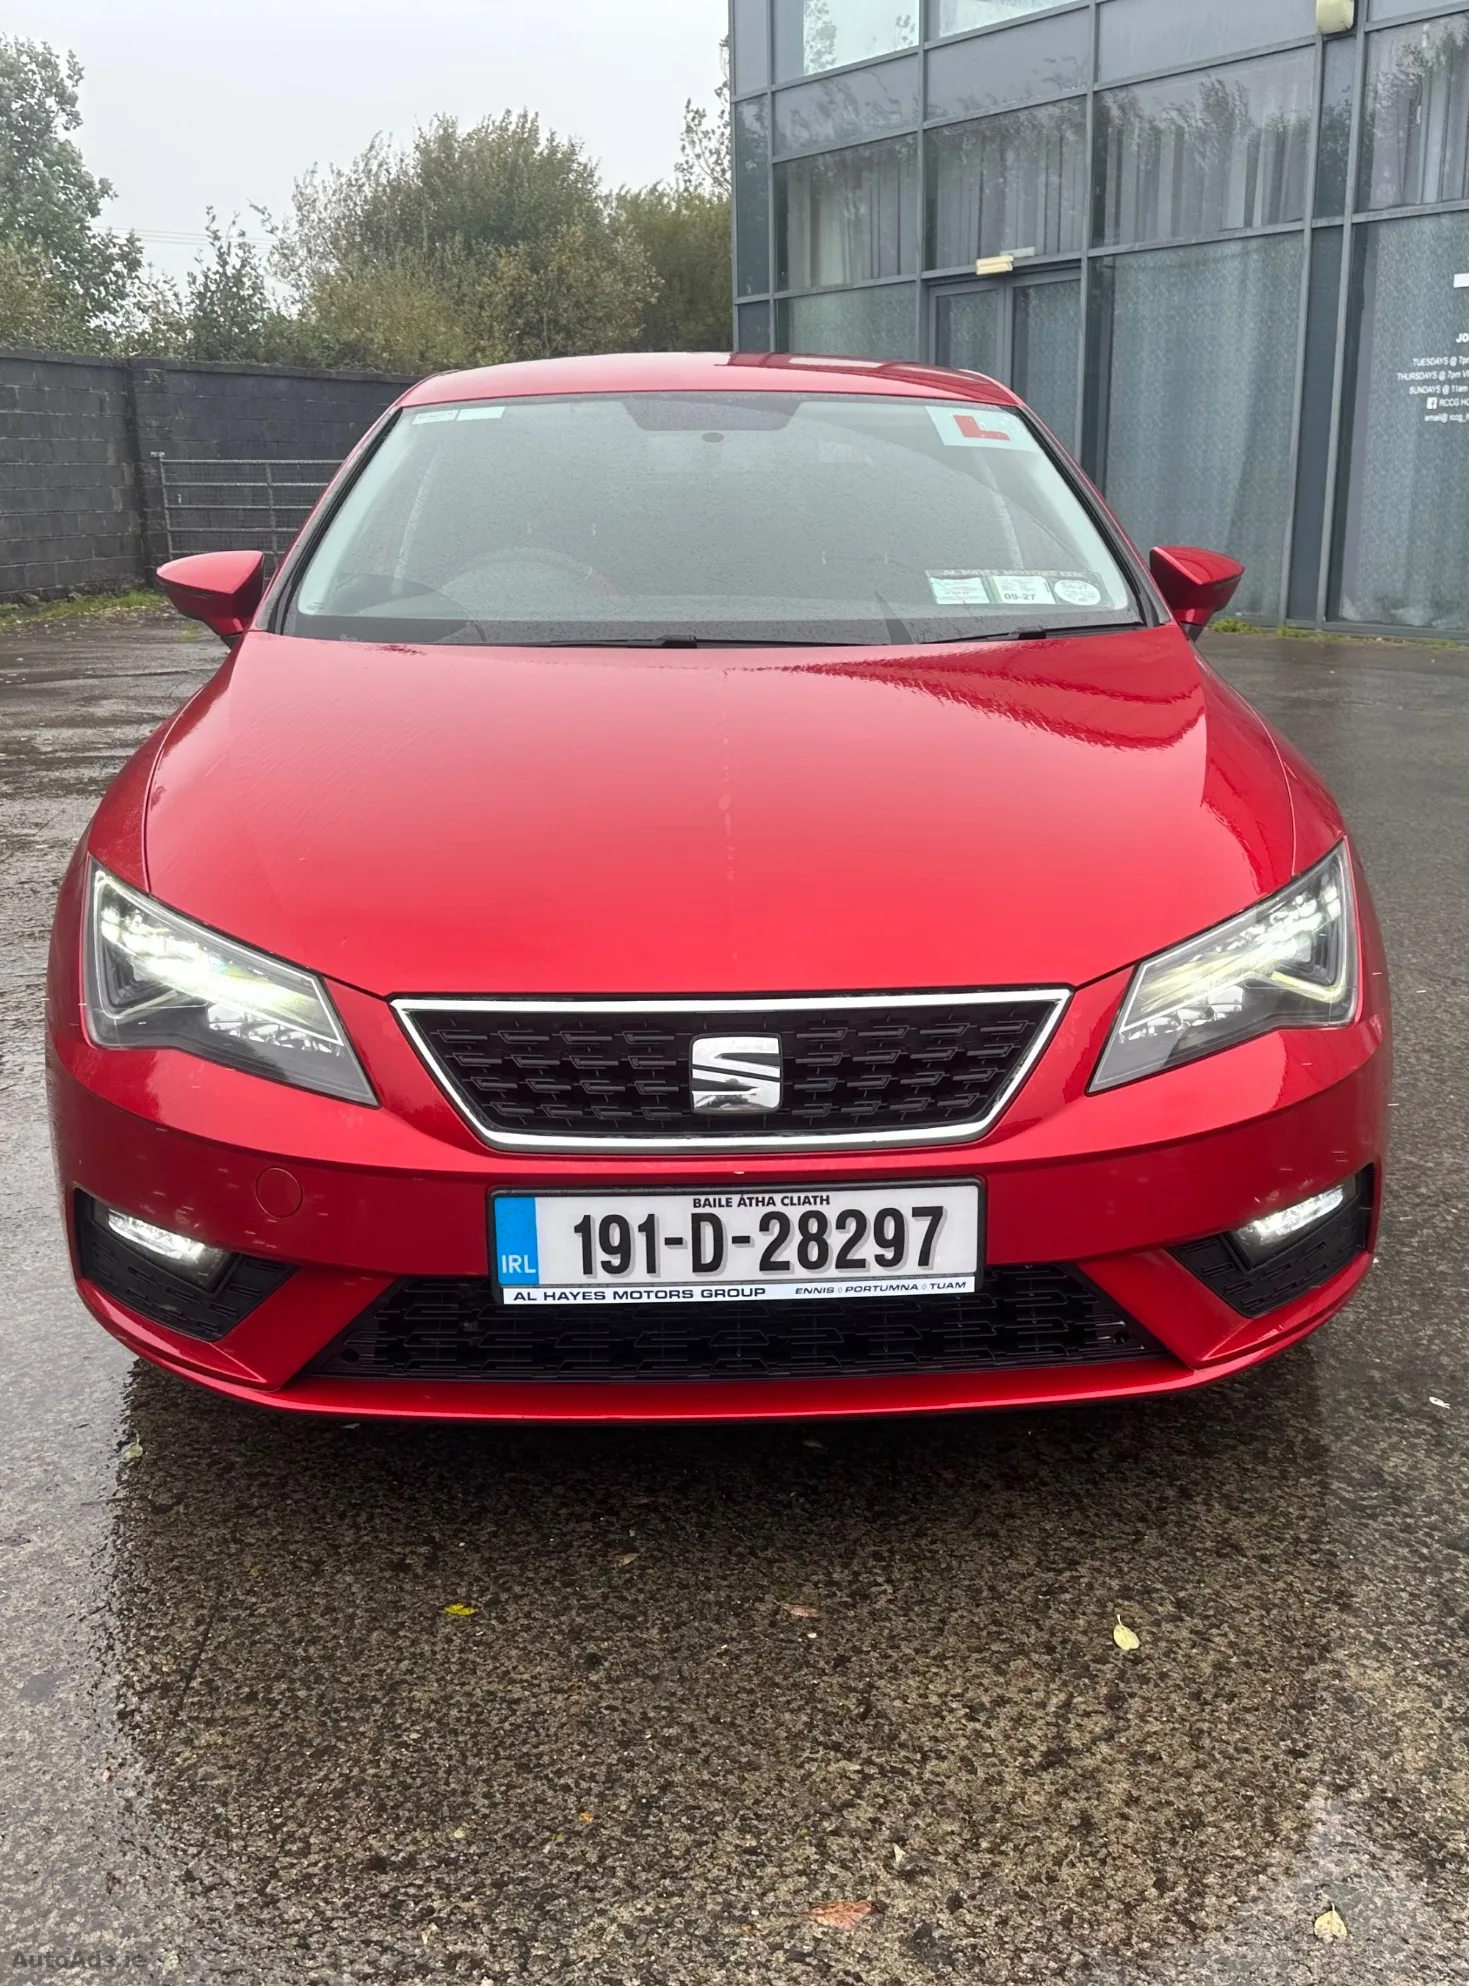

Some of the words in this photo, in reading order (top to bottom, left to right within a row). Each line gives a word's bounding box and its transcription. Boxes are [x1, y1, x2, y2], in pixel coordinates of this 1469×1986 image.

[1412, 356, 1449, 367] TUESDAYS
[1450, 356, 1457, 366] @
[1397, 370, 1438, 381] THURSDAYS
[1439, 370, 1446, 381] @
[1409, 384, 1441, 395] SUNDAYS
[1442, 384, 1450, 395] @
[1451, 384, 1468, 392] 11am
[1439, 397, 1460, 407] RCCG
[953, 414, 1011, 441] L
[1004, 593, 1036, 601] 09-27
[693, 1198, 733, 1208] BAILE
[737, 1194, 775, 1207] ÁTHA
[781, 1195, 830, 1206] CLIATH
[574, 1206, 944, 1275] 191-D-28297
[501, 1254, 536, 1274] IRL
[513, 1291, 537, 1301] AL
[543, 1291, 606, 1301] HAYES
[613, 1289, 694, 1300] MOTORS
[701, 1288, 766, 1298] GROUP
[795, 1286, 834, 1295] ENNIS
[845, 1284, 918, 1293] PORTUMNA
[930, 1281, 966, 1290] TUAM
